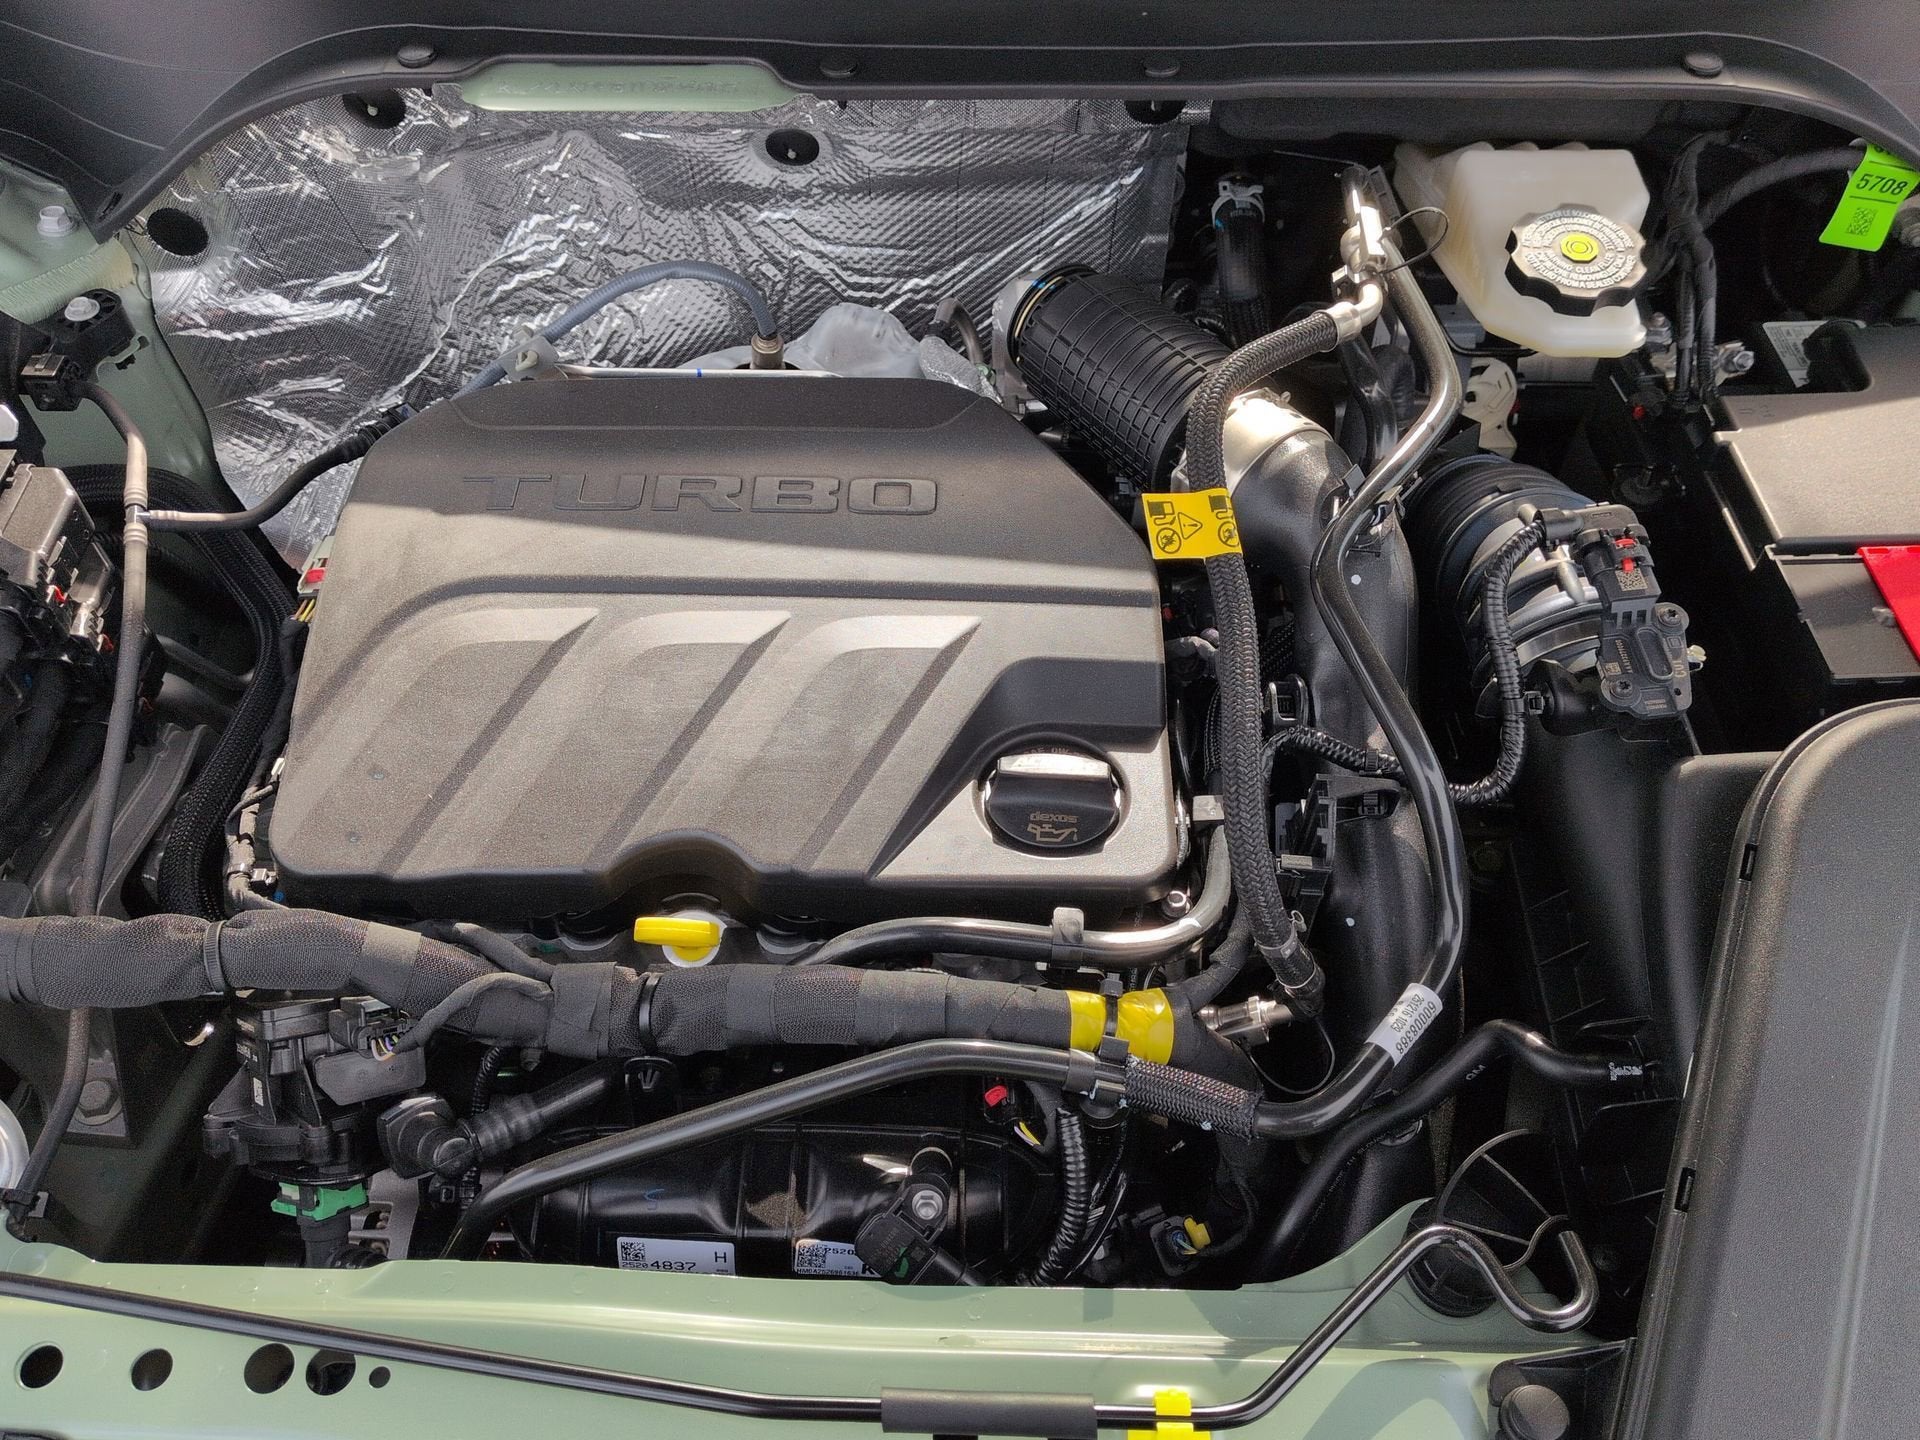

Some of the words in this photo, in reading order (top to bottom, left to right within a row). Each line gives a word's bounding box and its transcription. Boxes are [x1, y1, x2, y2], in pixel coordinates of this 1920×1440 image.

[1856, 173, 1908, 196] 5708
[1556, 276, 1580, 288] FROM
[463, 473, 938, 516] TURBO
[1029, 811, 1080, 823] dexos
[1405, 993, 1425, 1018] 251216
[1390, 1016, 1409, 1033] 1029
[1395, 1001, 1437, 1055] 60008388
[714, 1251, 727, 1263] H
